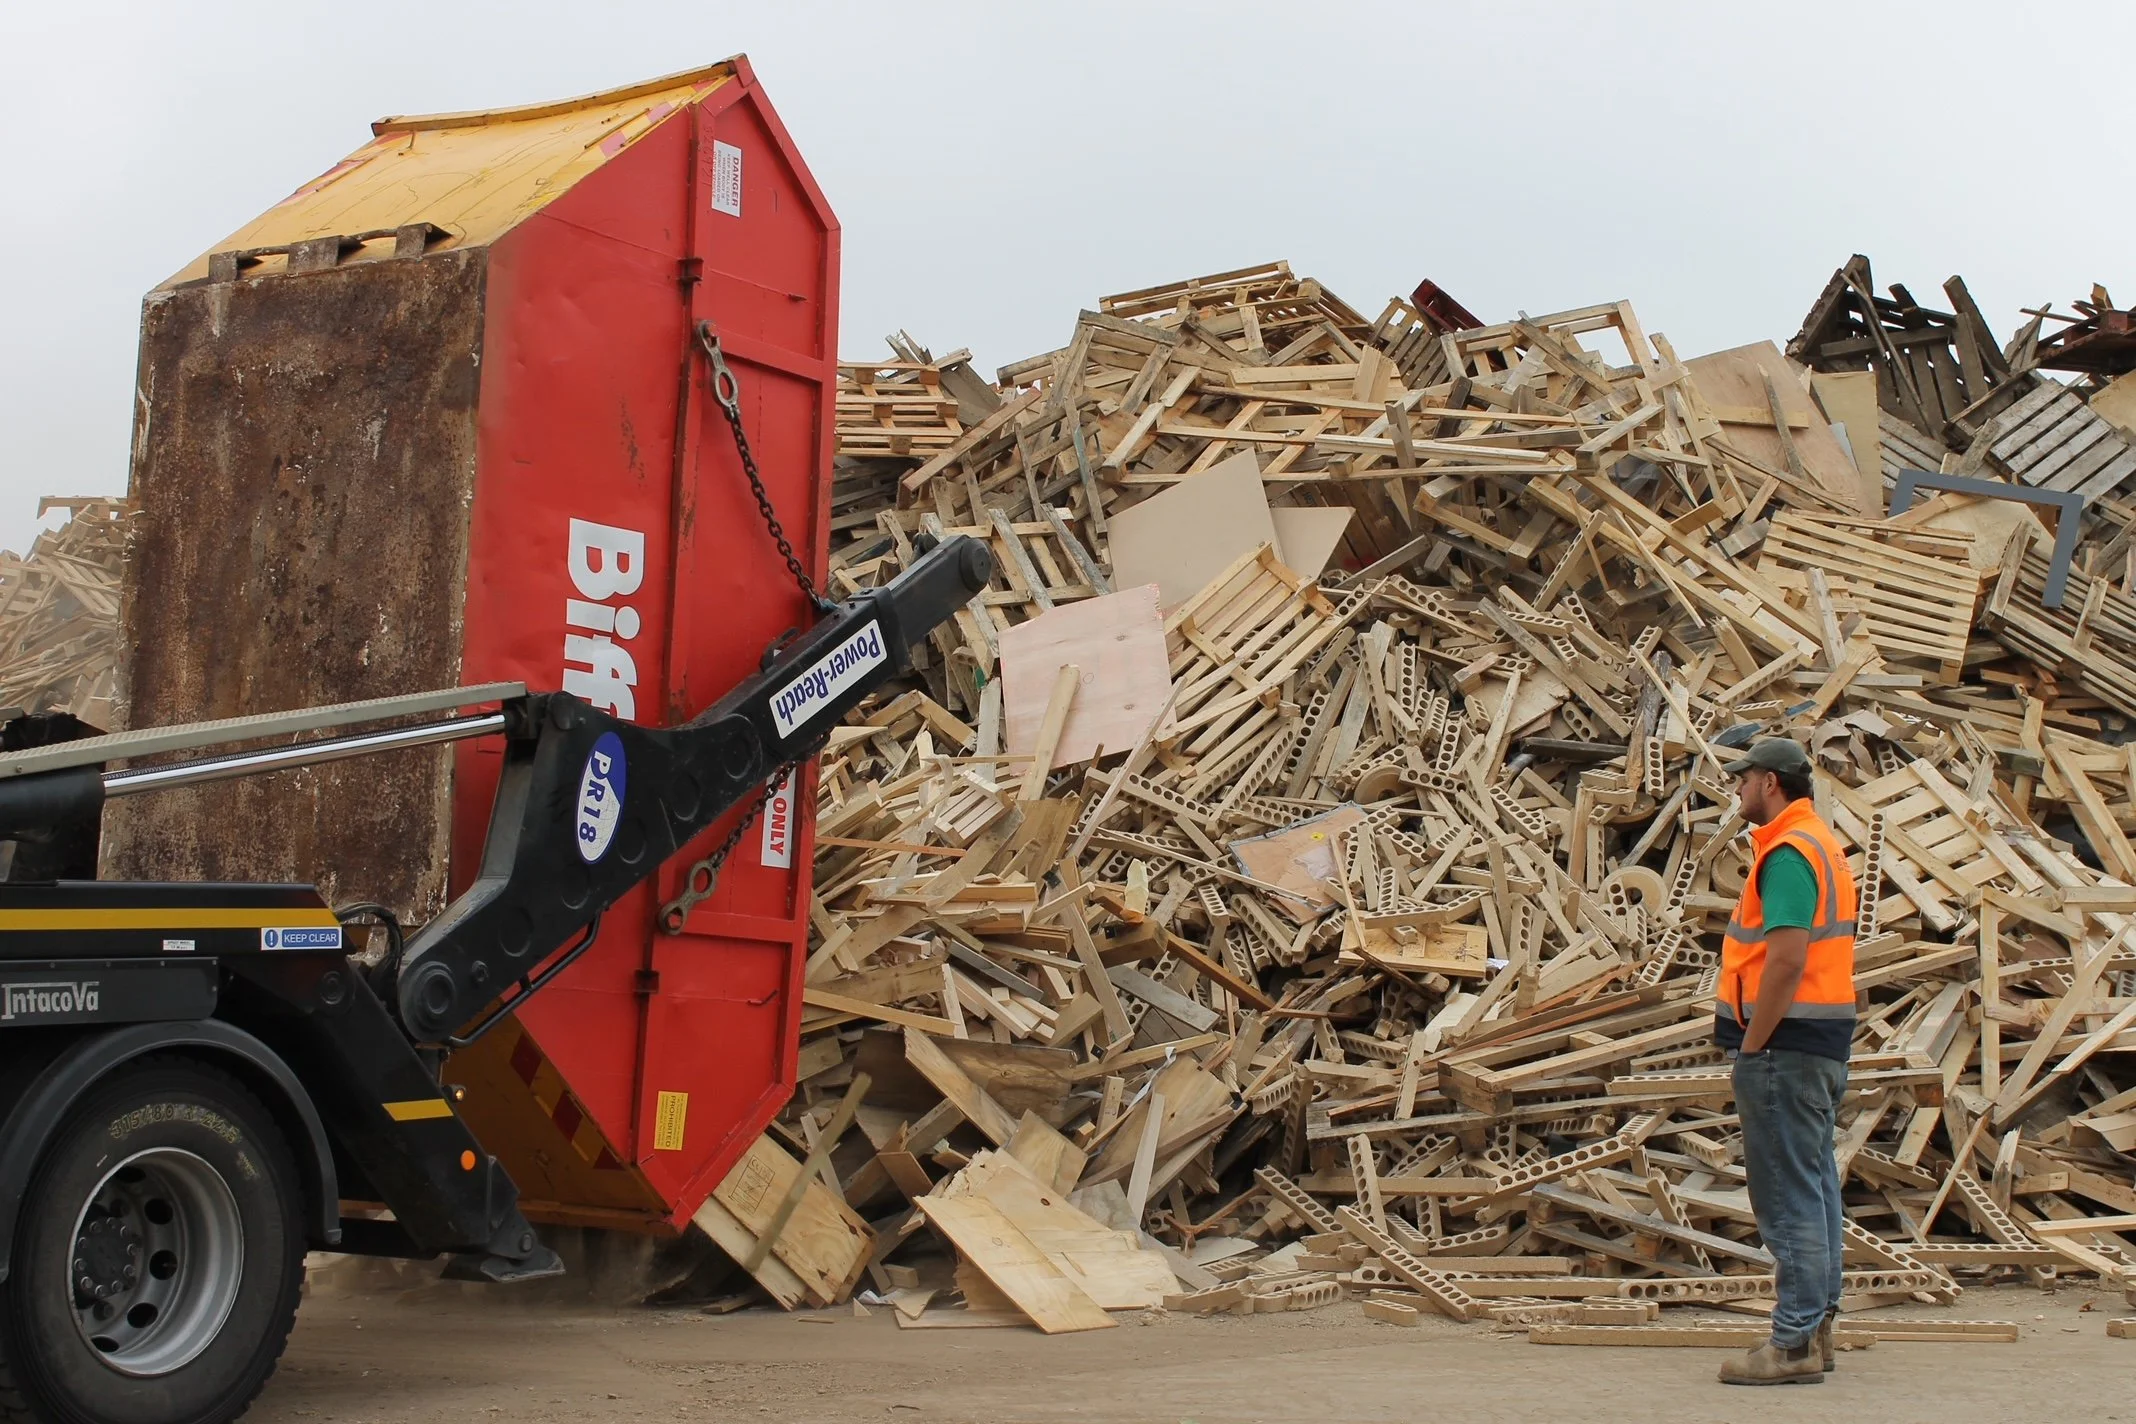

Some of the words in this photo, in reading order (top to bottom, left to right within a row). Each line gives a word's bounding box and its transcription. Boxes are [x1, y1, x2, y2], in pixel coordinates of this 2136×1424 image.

[732, 157, 740, 207] DANGER
[562, 517, 645, 721] Biff
[776, 628, 881, 726] Power-Reach
[580, 751, 612, 842] PR18
[770, 797, 787, 856] ONLY
[284, 933, 307, 943] KEEP
[308, 933, 337, 943] CLEAR
[1, 981, 100, 1020] IntacoVa
[665, 1095, 676, 1147] PROHIBITED
